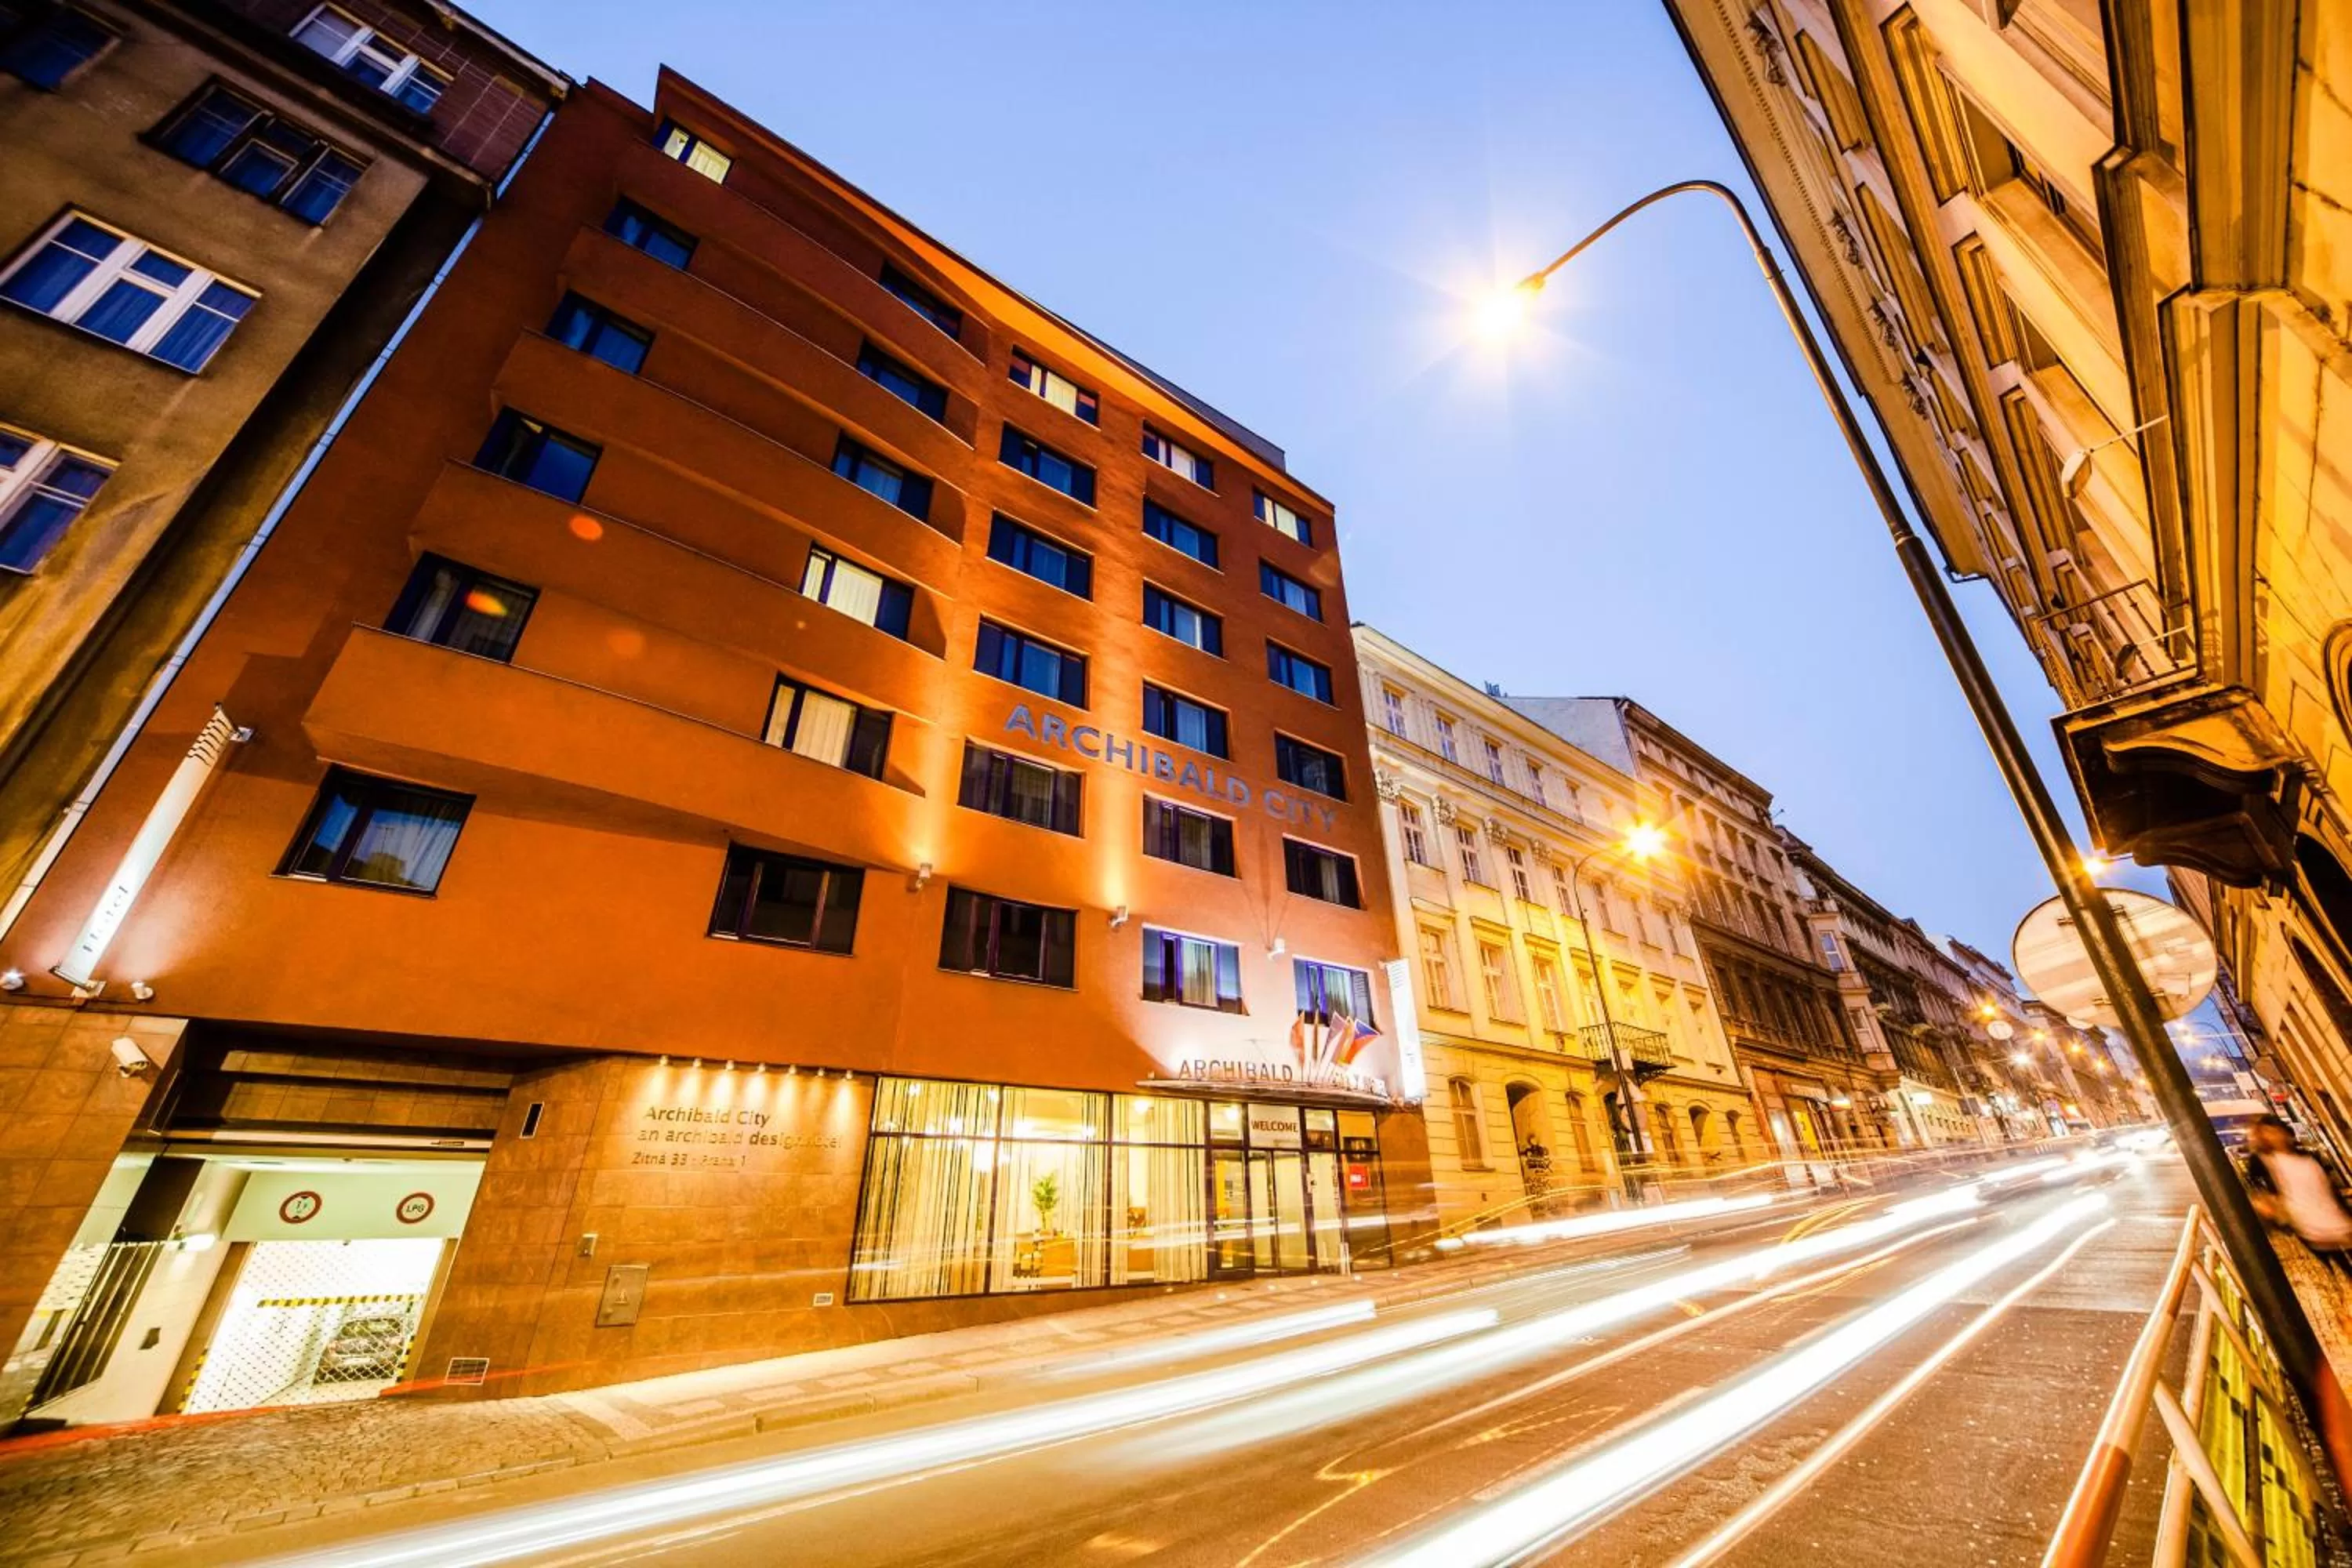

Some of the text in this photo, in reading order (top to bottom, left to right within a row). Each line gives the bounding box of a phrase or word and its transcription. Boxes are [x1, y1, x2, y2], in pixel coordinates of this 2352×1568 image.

[1004, 702, 1336, 833] ARCHIBALD CITY
[1178, 1058, 1294, 1083] ARCHIBALD
[644, 1106, 771, 1129] Archibald City
[1250, 1120, 1299, 1133] WELCOME
[637, 1129, 660, 1142] an
[406, 1203, 425, 1213] LPG
